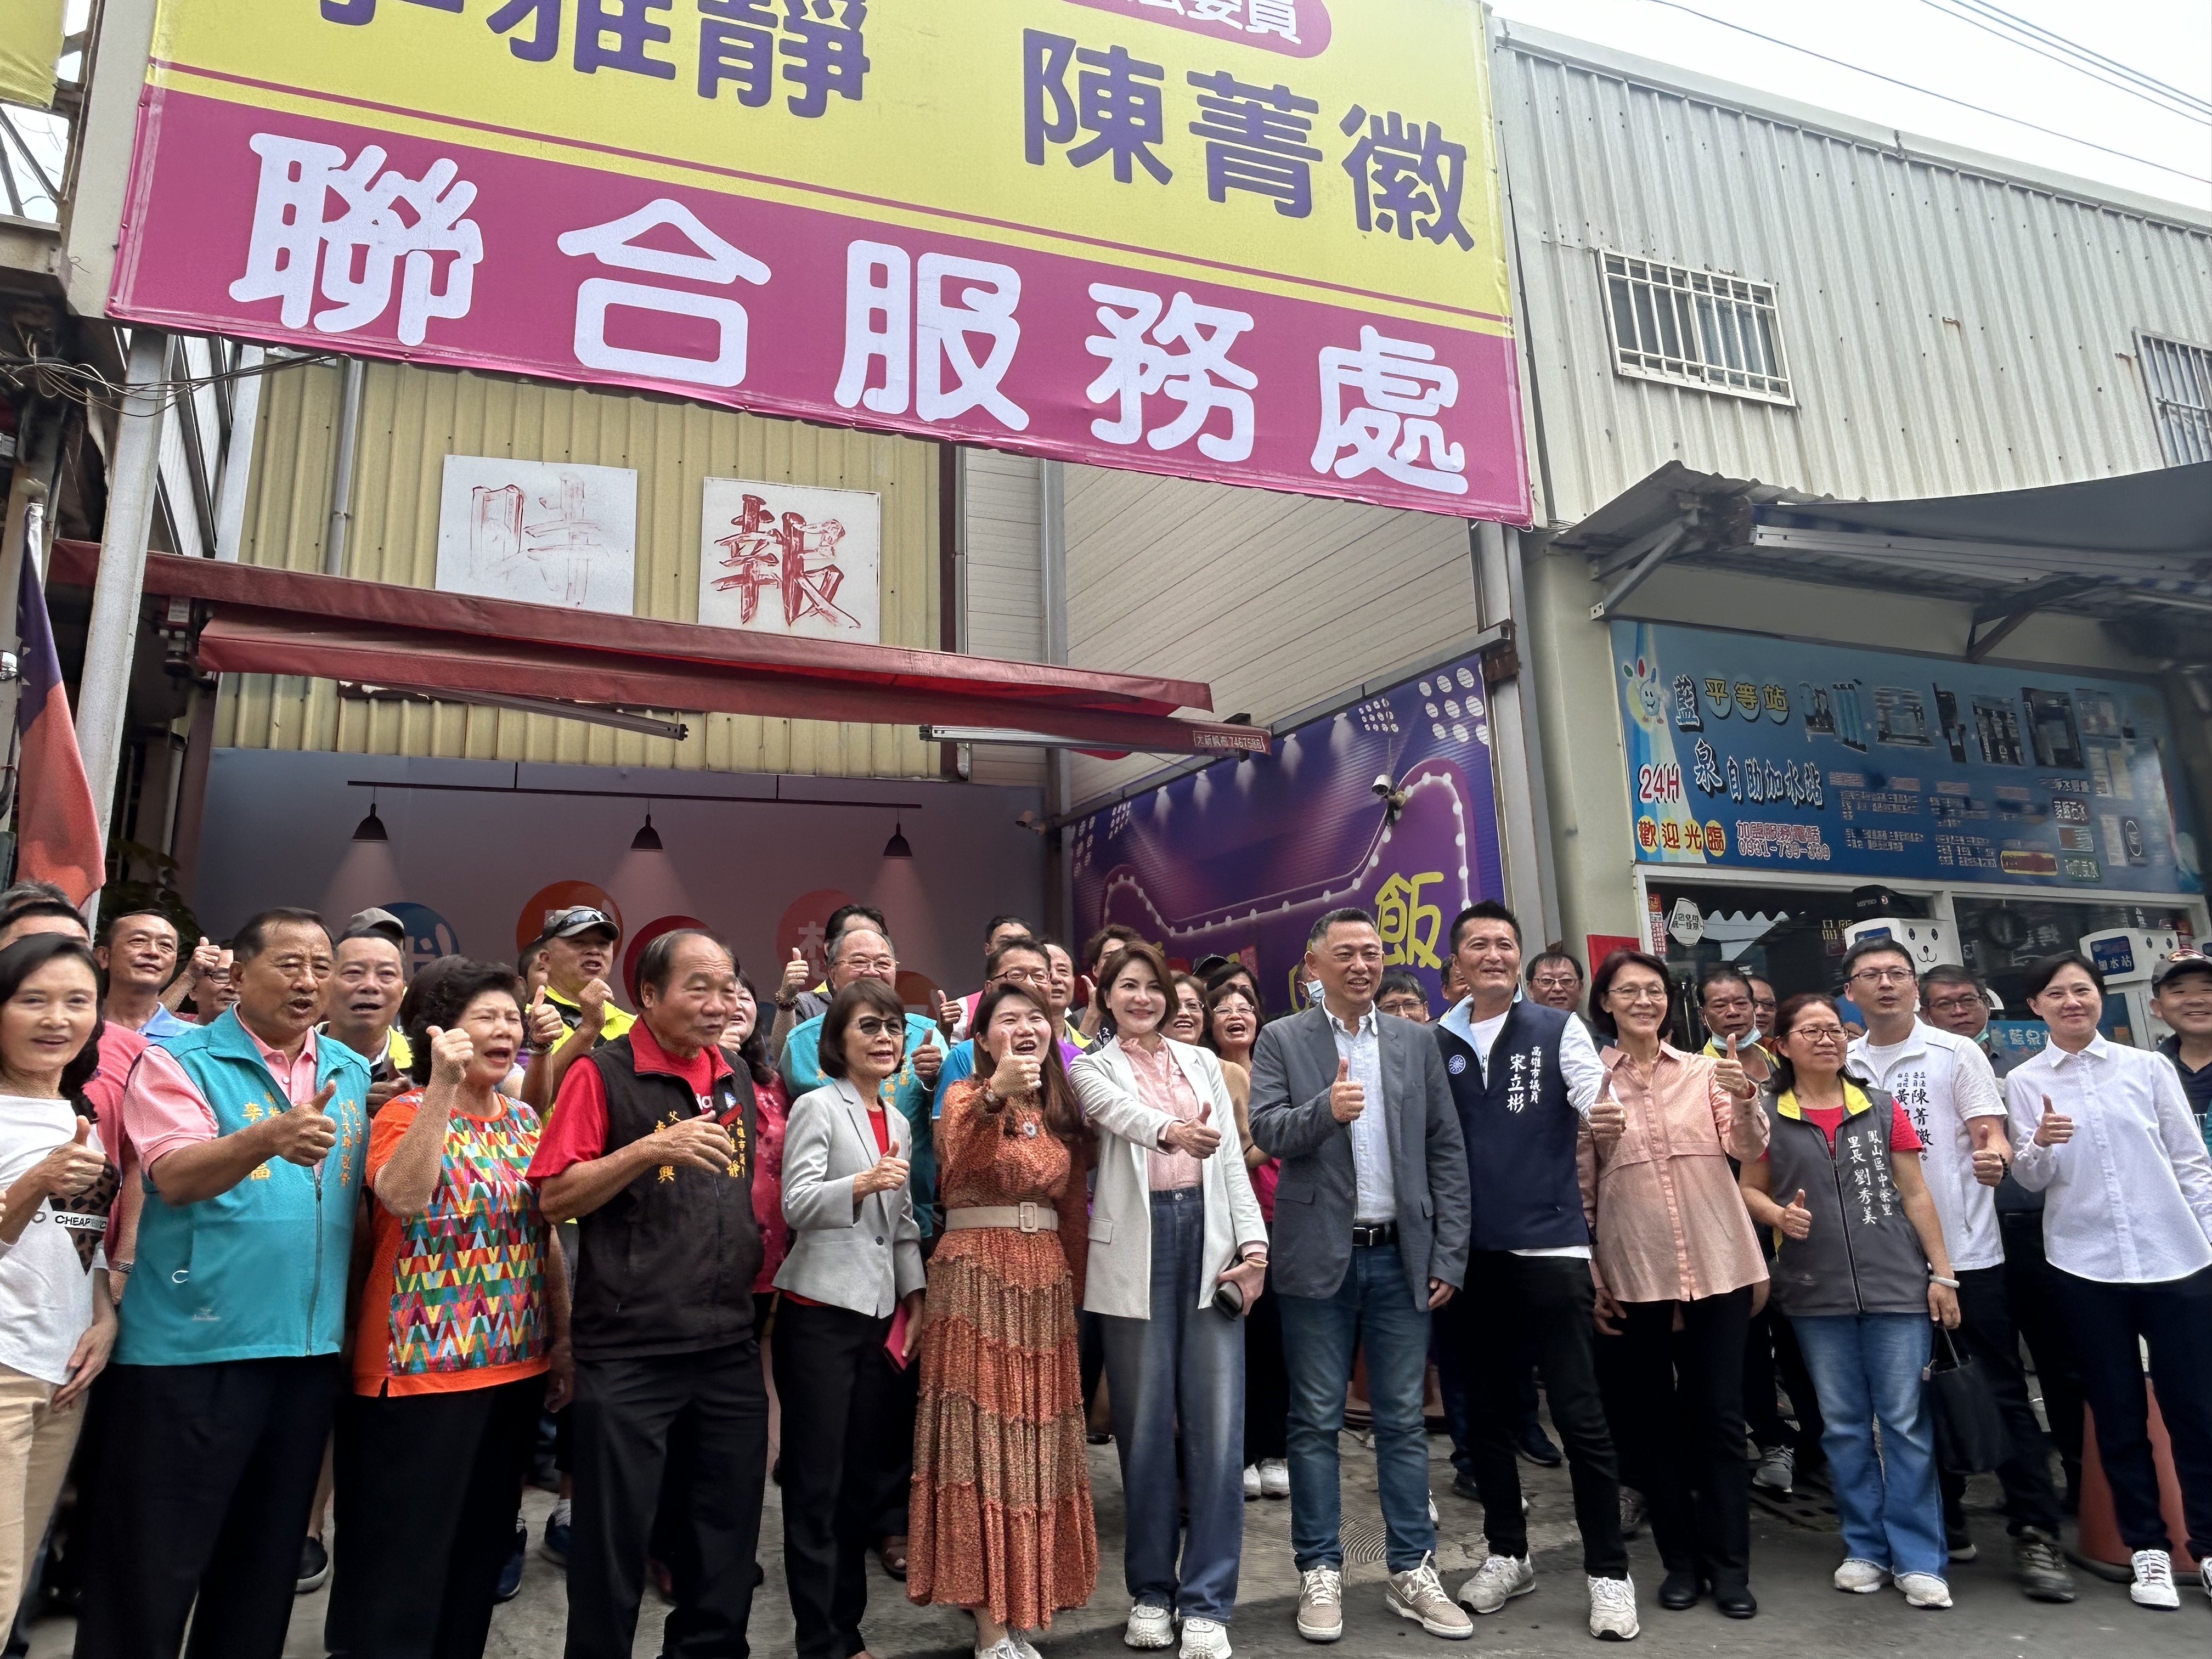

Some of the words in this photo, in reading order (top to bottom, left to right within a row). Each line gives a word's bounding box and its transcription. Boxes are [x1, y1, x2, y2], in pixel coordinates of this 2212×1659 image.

[1023, 28, 1475, 252] 陳菁徽
[228, 132, 1469, 495] 聯合服務處
[710, 493, 861, 629] 報
[1705, 678, 1789, 711] 平等站
[1640, 765, 1680, 802] 24H
[1638, 820, 1726, 851] 歡迎光臨
[1375, 872, 1444, 969] 飯
[1506, 1053, 1527, 1114] 宋立彬
